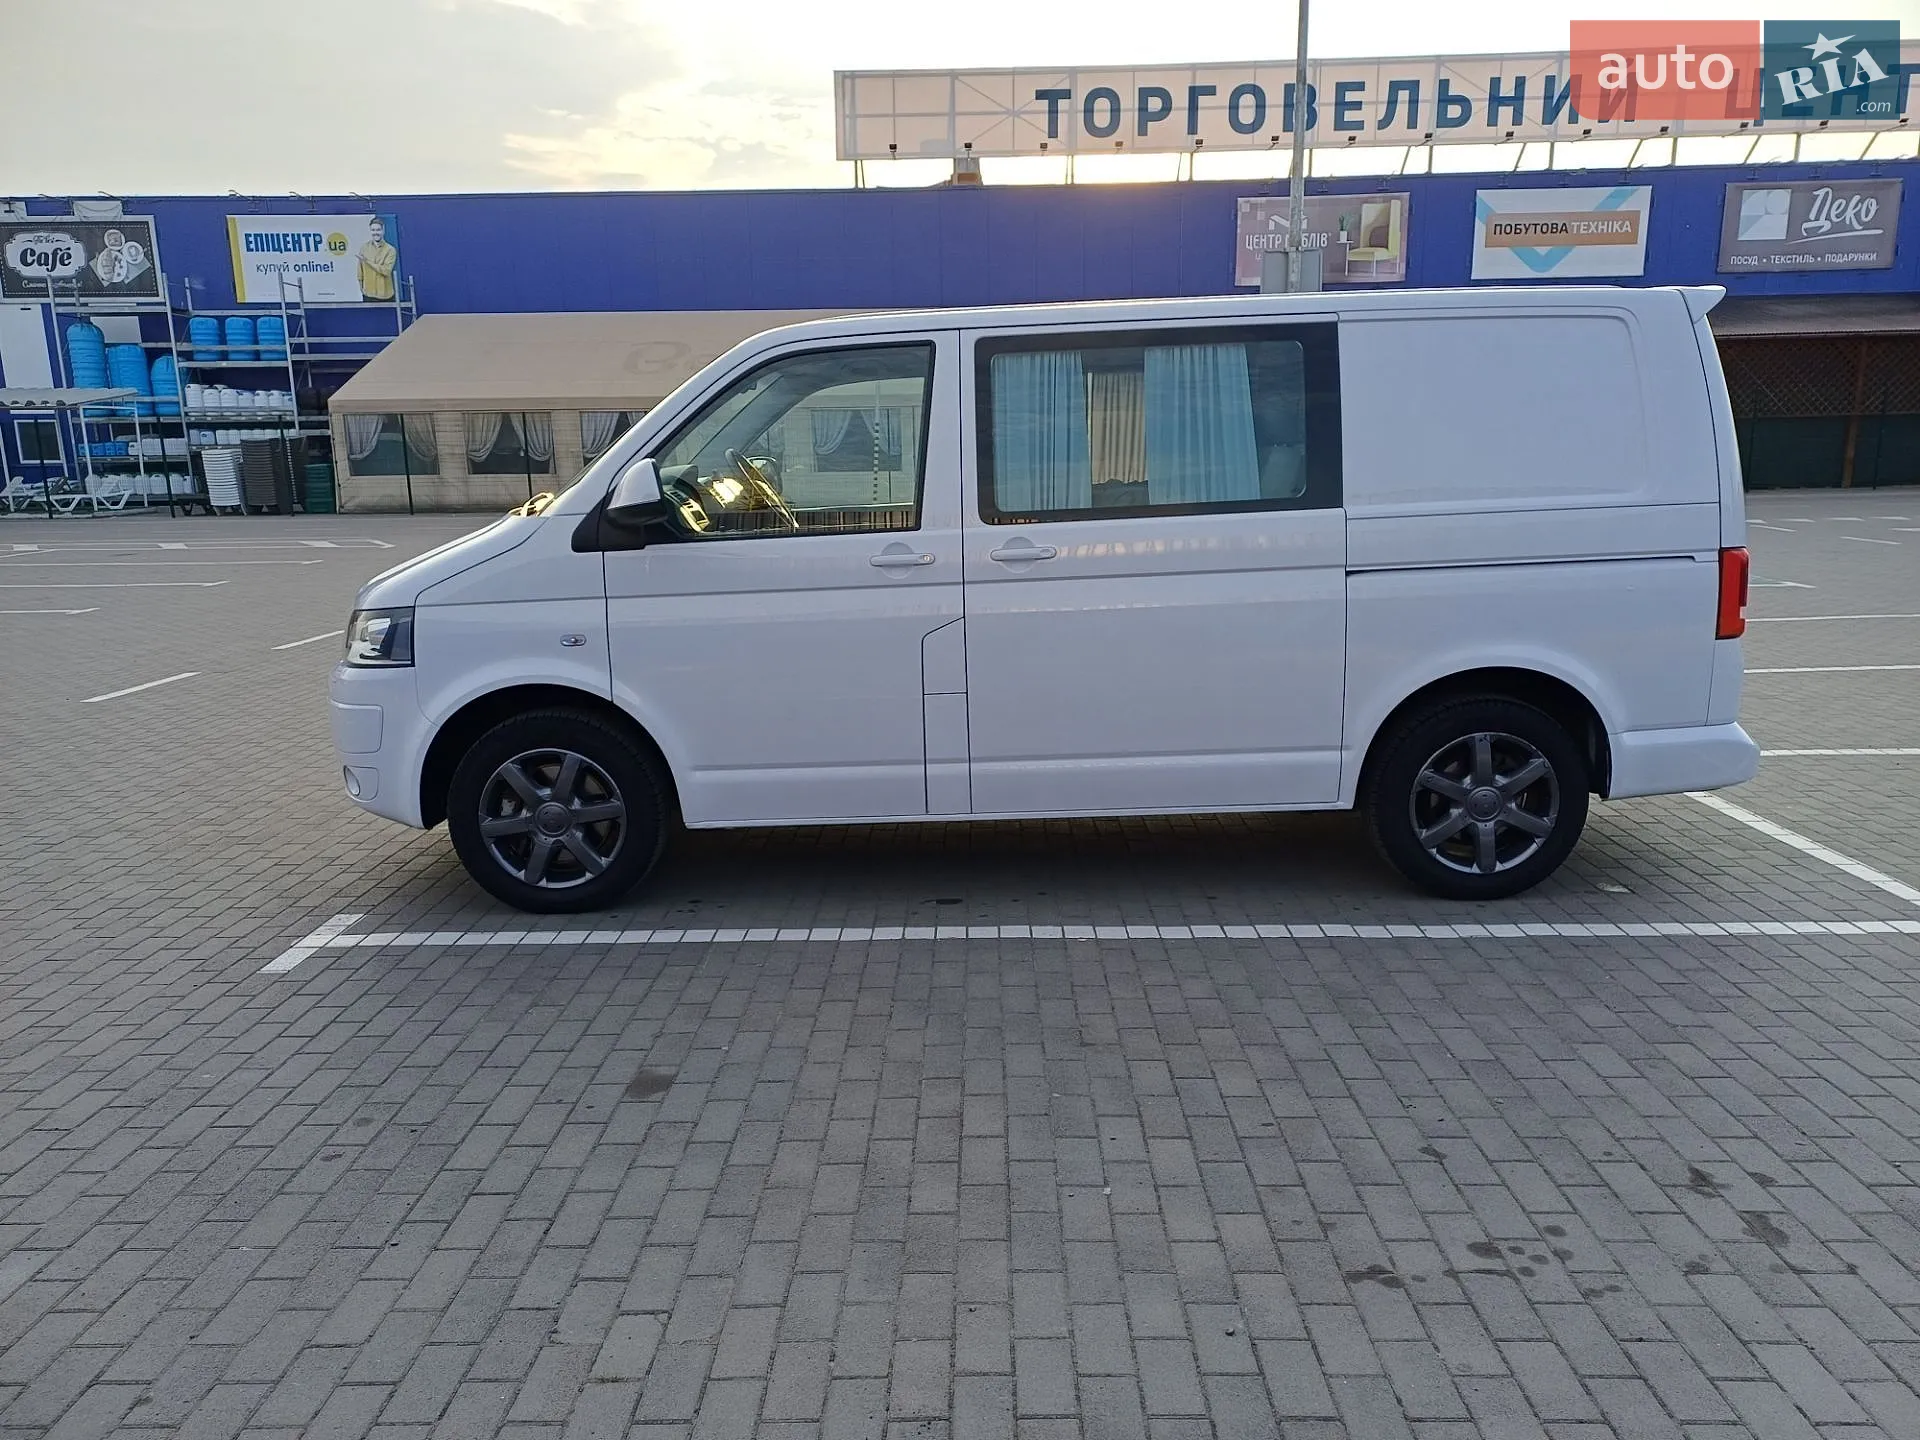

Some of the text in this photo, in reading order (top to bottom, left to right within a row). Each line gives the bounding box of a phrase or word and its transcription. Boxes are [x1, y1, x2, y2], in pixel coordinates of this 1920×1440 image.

[1801, 187, 1879, 236] Деко
[1494, 220, 1632, 235] ПОБУТОВА ТЕХНІКА
[20, 247, 72, 272] Café
[1730, 252, 1877, 265] ПОСУД ТЕКСТИЛЬ ПОДАРУНКИ
[256, 260, 334, 275] купуй online!
